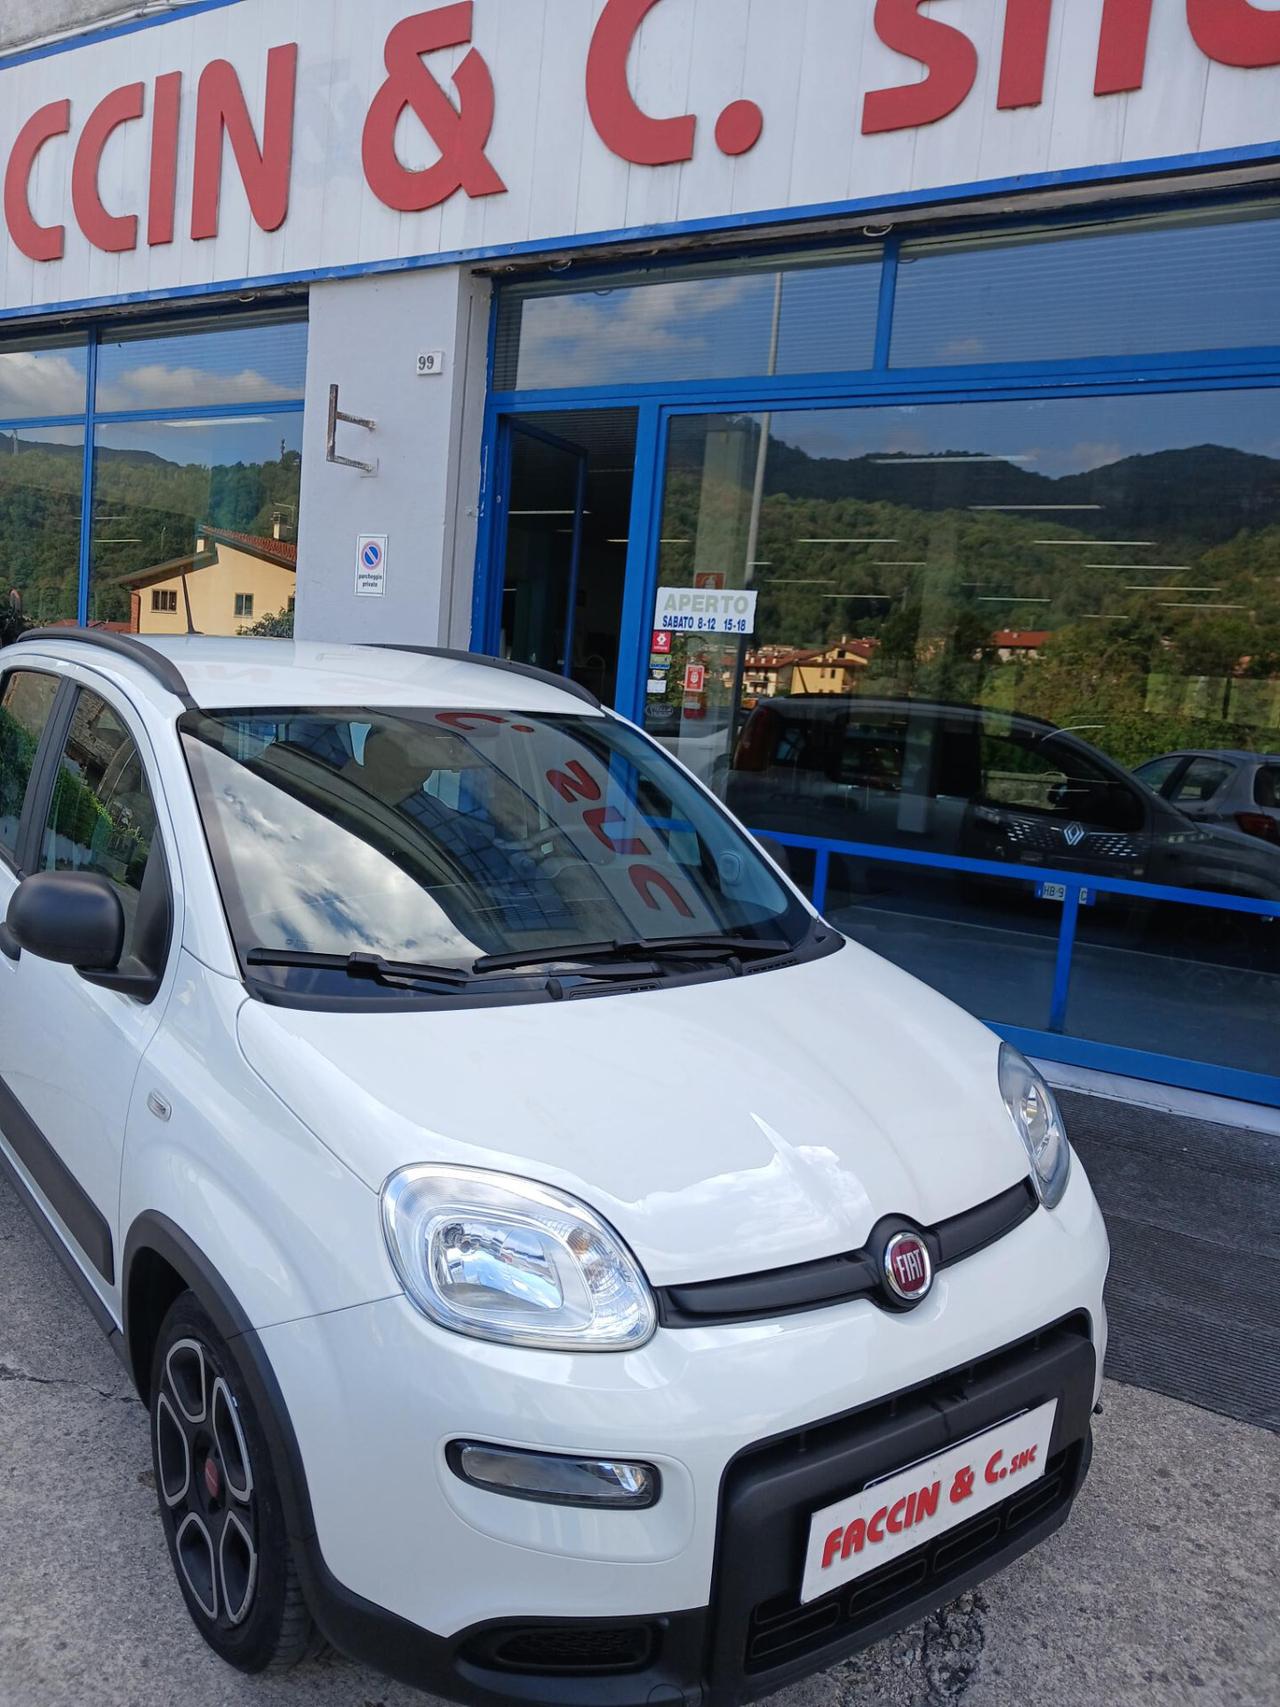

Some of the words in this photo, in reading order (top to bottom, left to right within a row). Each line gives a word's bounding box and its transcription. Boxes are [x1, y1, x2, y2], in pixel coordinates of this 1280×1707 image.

[361, 0, 509, 212] &
[418, 355, 434, 371] 99
[665, 594, 749, 614] APERTO
[662, 615, 694, 629] SABATO
[697, 617, 716, 630] 8-12
[724, 618, 747, 632] 15-18
[895, 1249, 924, 1284] FIAT
[821, 1479, 942, 1570] FACCIN
[949, 1464, 975, 1504] &
